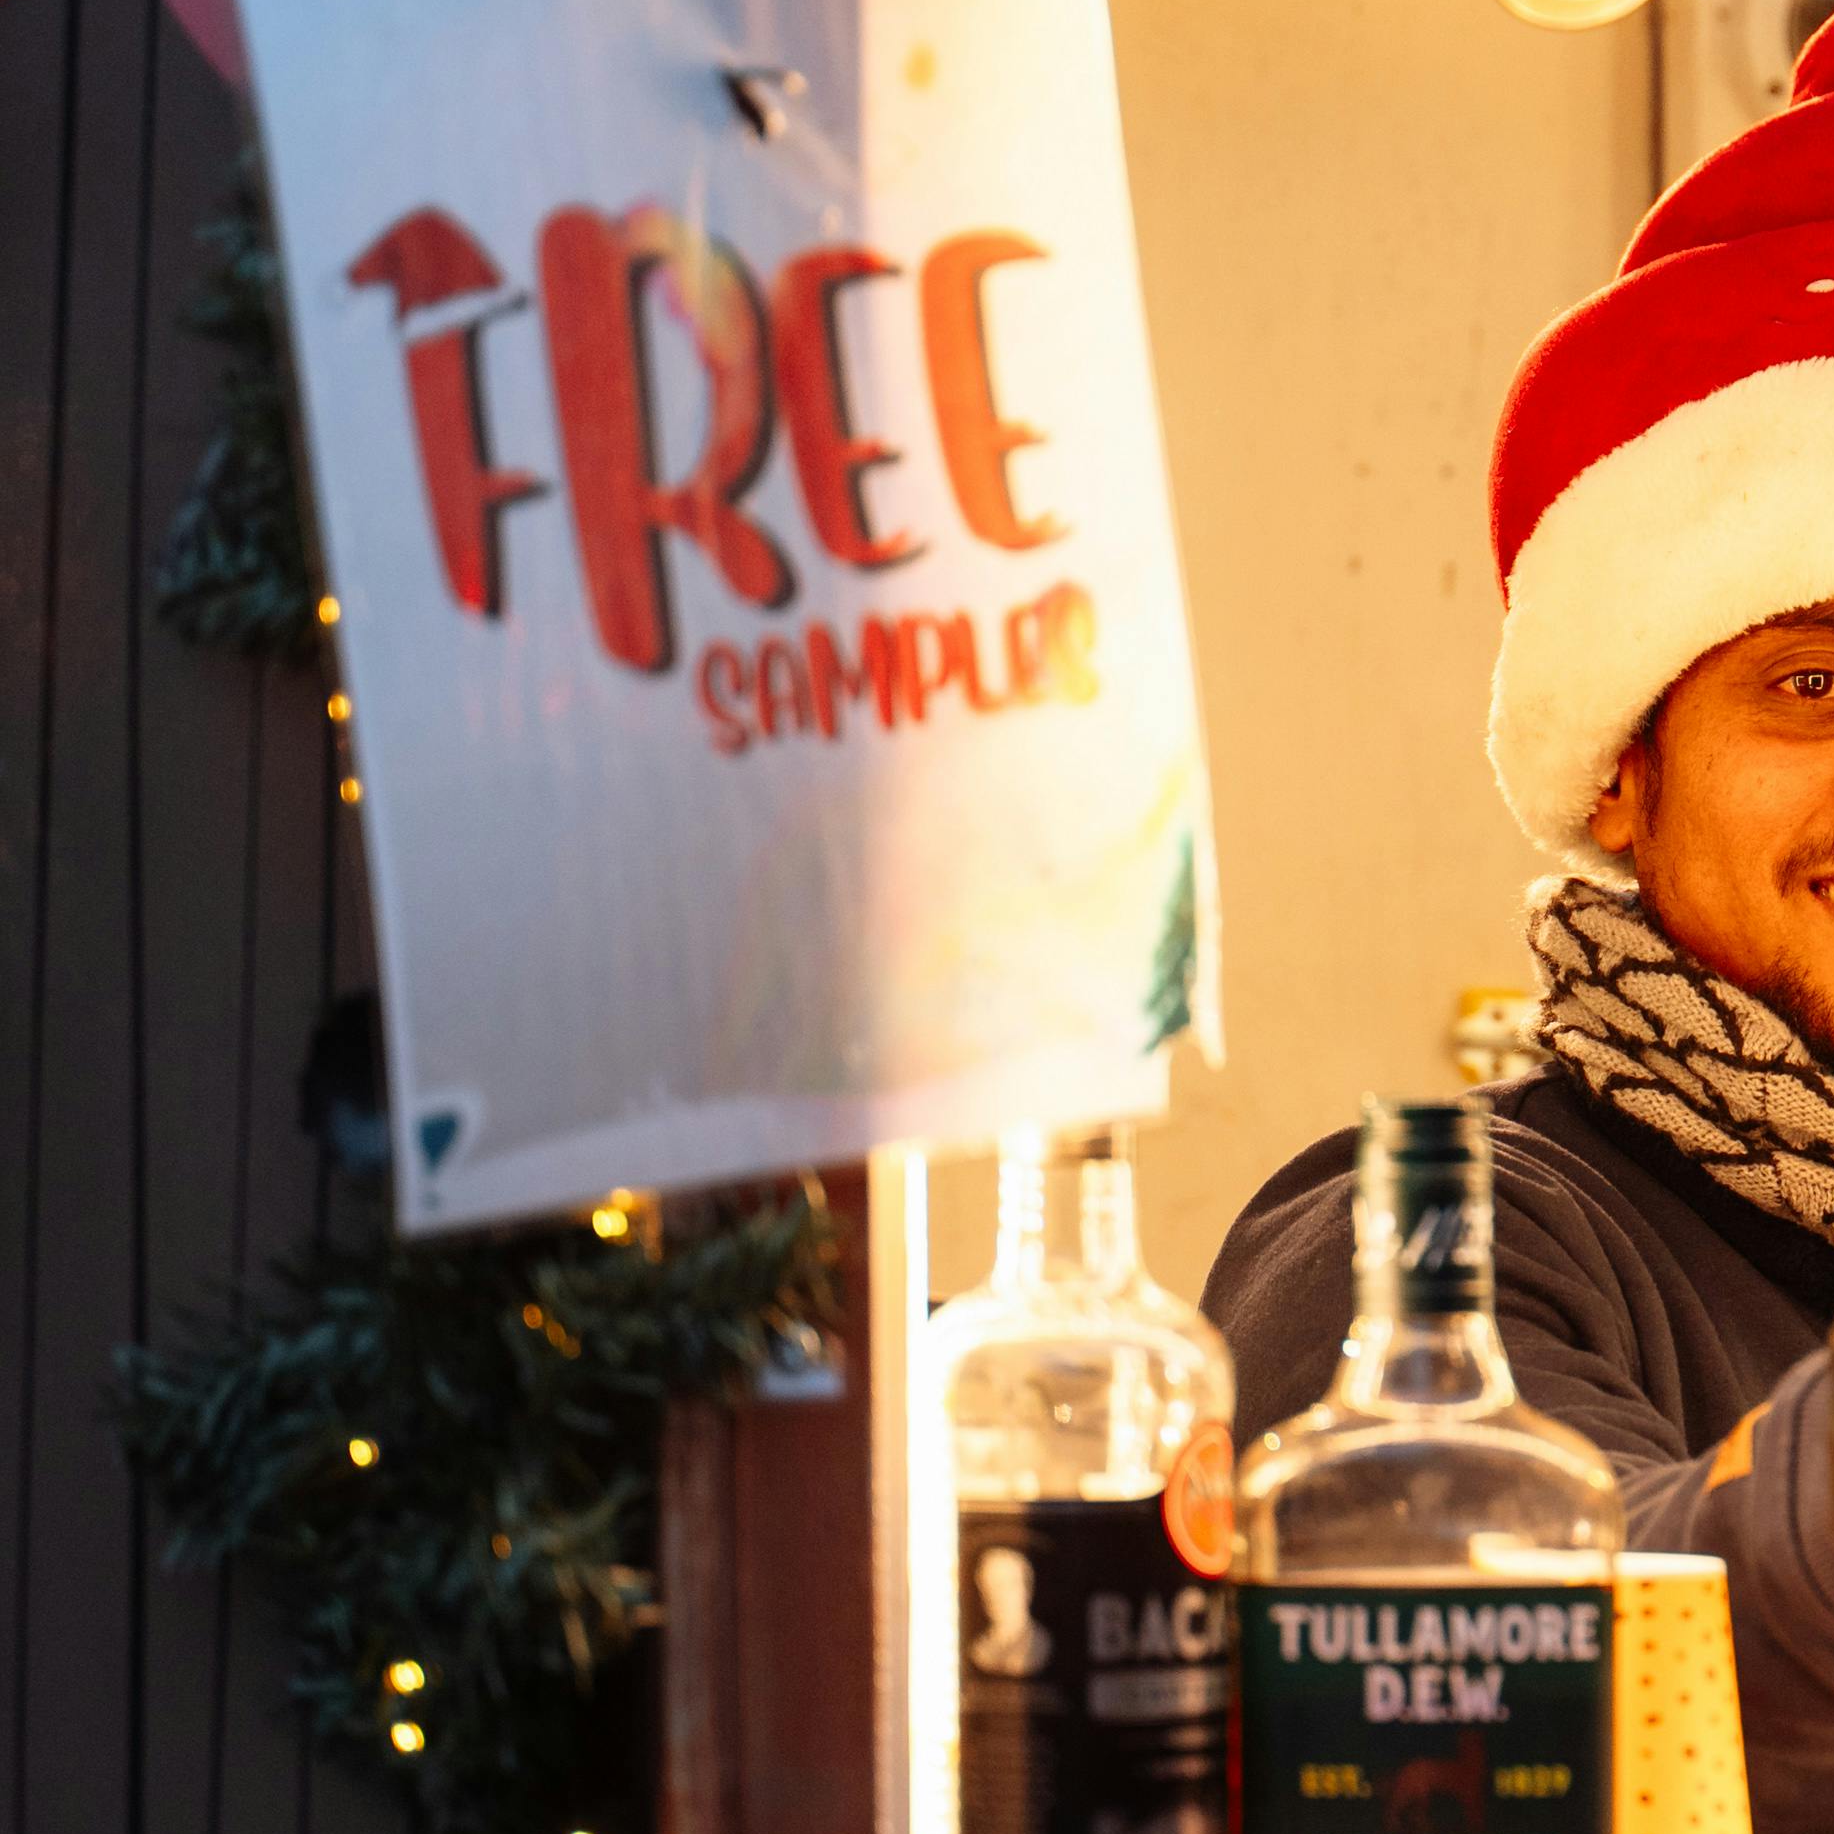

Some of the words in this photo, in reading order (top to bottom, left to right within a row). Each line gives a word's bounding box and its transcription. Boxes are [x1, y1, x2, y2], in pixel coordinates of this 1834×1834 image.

[385, 199, 1068, 675] FREE
[1268, 1602, 1600, 1665] TULLAMORE
[1364, 1664, 1511, 1723] D.E.W.
